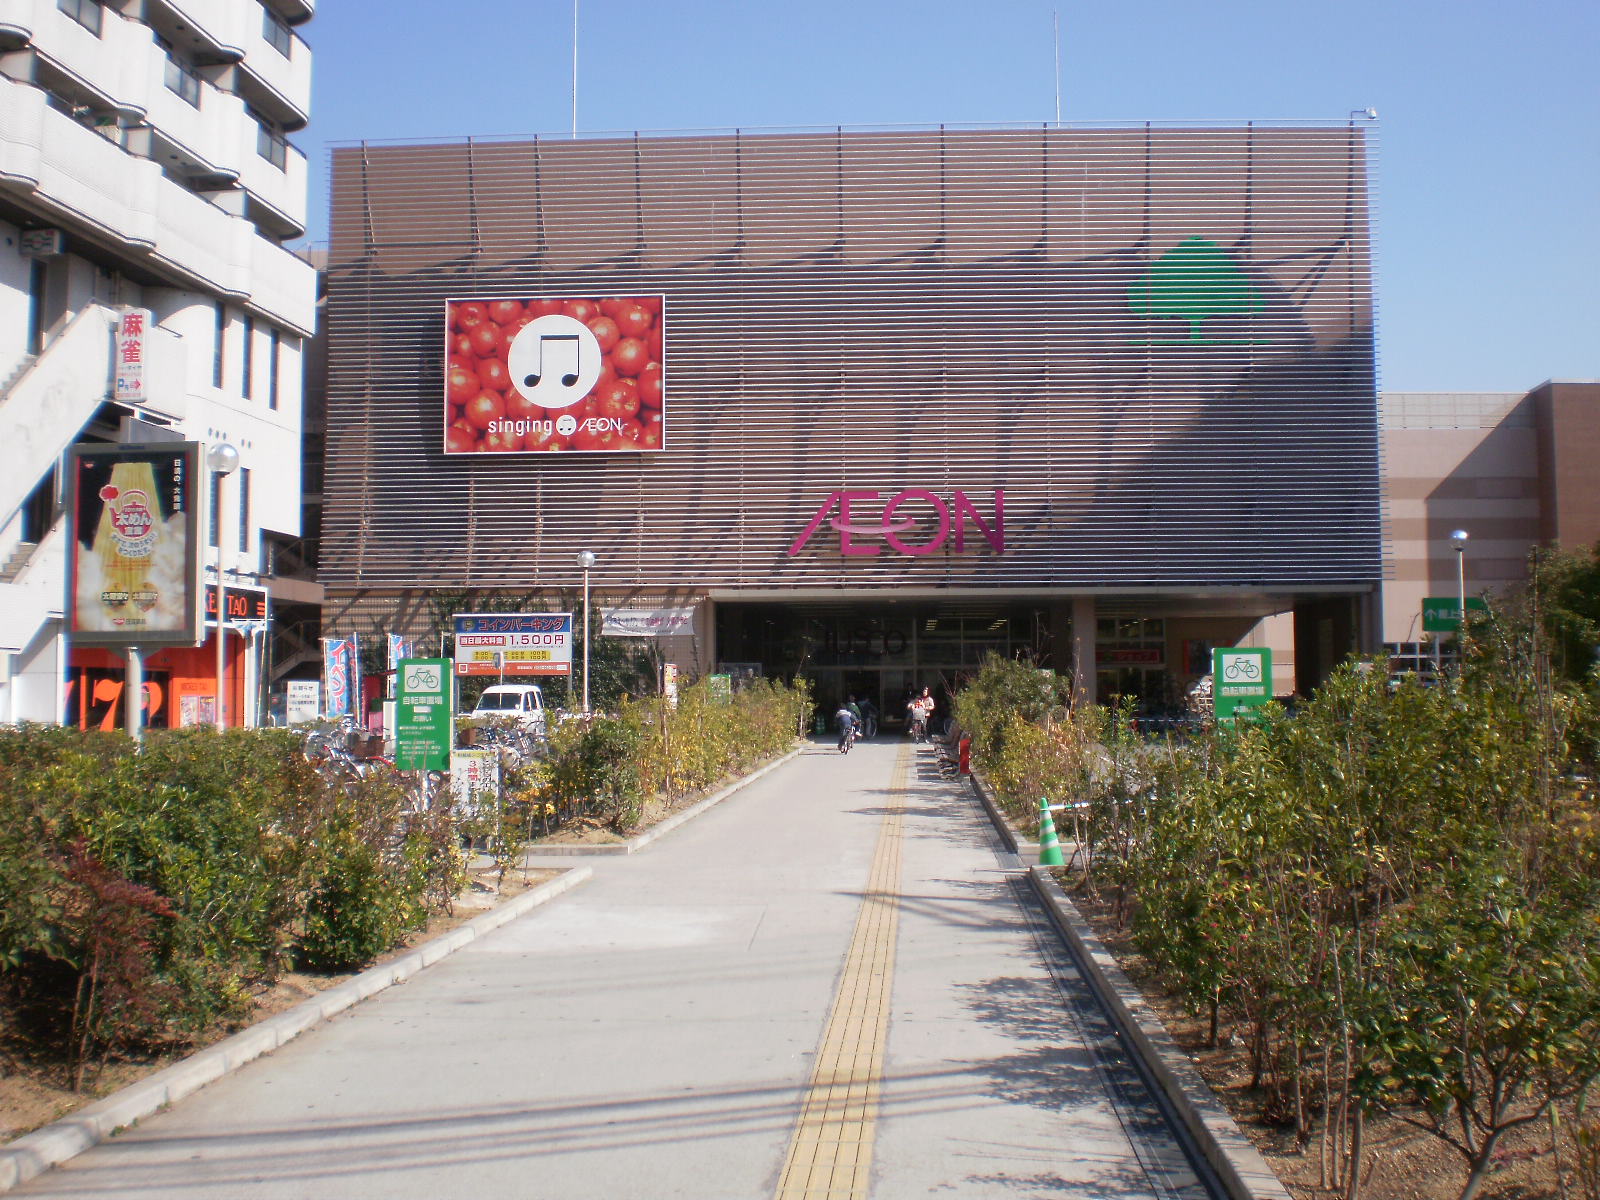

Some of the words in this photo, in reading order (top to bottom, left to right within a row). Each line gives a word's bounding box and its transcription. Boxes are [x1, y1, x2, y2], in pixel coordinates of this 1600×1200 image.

[120, 313, 143, 363] 麻雀
[488, 417, 552, 436] singing
[226, 595, 248, 616] TAO
[460, 636, 505, 645] 当日最大料金
[509, 634, 564, 645] 1,500円
[402, 696, 443, 705] 自転車置場
